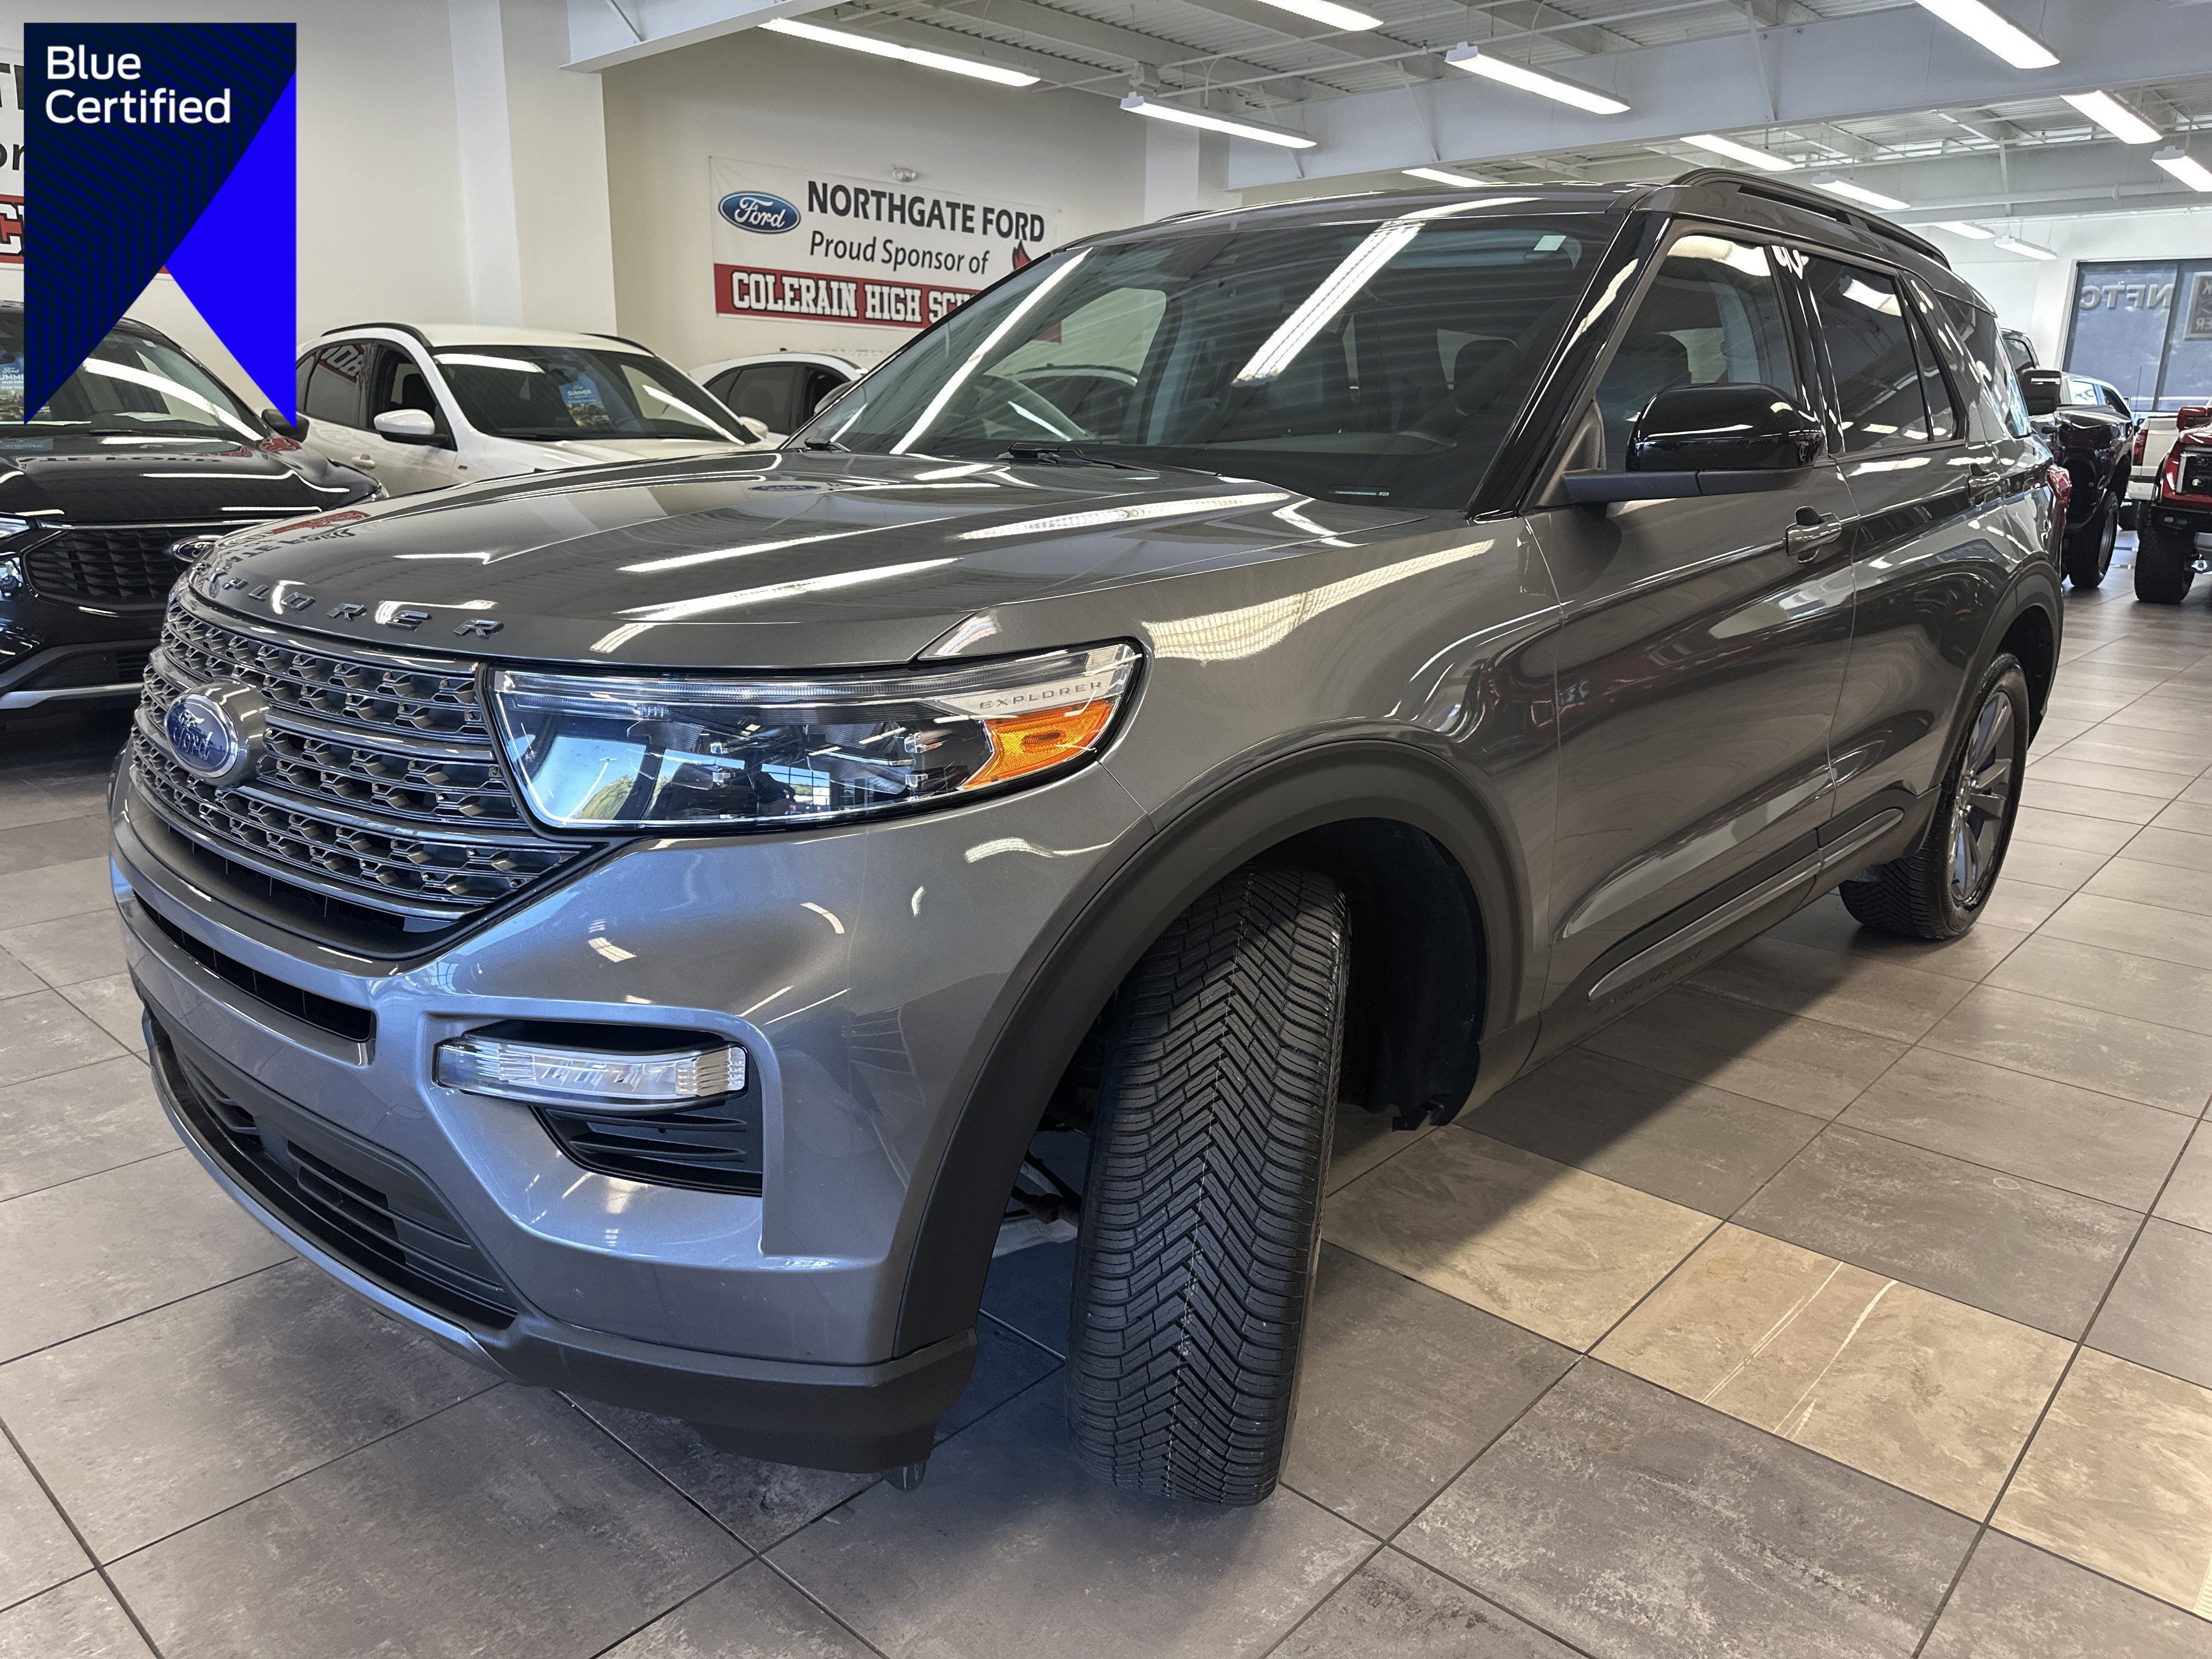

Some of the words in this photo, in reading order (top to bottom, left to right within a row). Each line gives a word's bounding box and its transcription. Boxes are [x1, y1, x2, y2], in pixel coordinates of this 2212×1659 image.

[734, 196, 786, 228] Ford
[808, 181, 975, 234] NORTHGATE
[983, 207, 1045, 242] FORD
[810, 230, 877, 262] Proud
[881, 239, 965, 272] Sponsor
[969, 250, 989, 274] of
[732, 271, 858, 318] COLERAIN
[864, 284, 922, 323] HIGH
[979, 681, 1102, 709] EXPLORER
